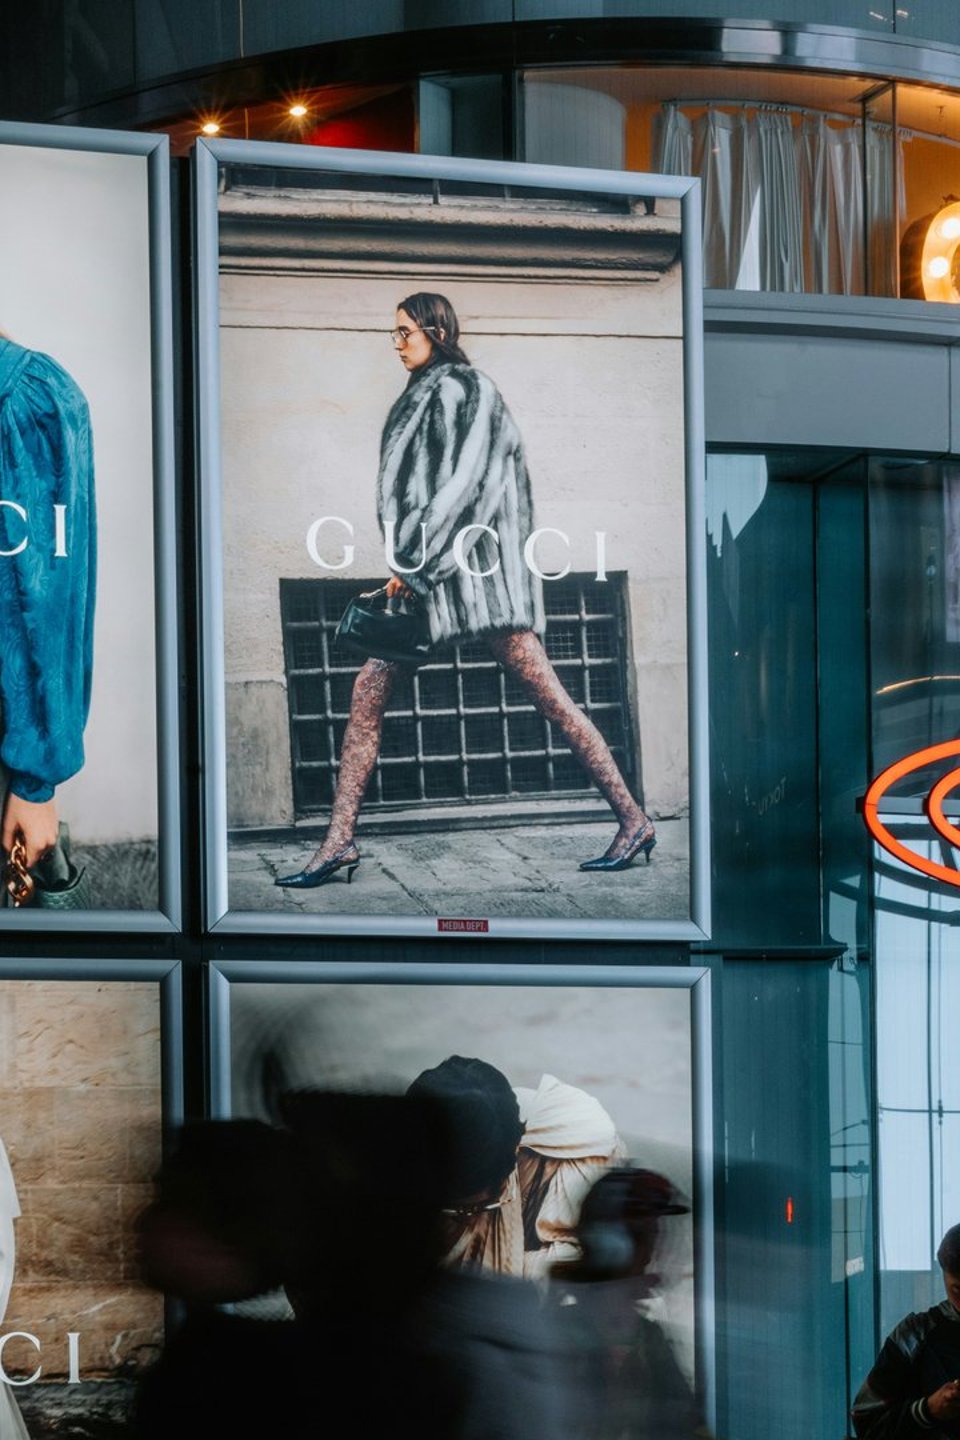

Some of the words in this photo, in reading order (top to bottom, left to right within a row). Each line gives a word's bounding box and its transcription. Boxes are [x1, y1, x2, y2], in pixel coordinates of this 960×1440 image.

[305, 516, 609, 583] GUCCI
[442, 920, 465, 930] MEDIA
[466, 921, 486, 931] DEPT.
